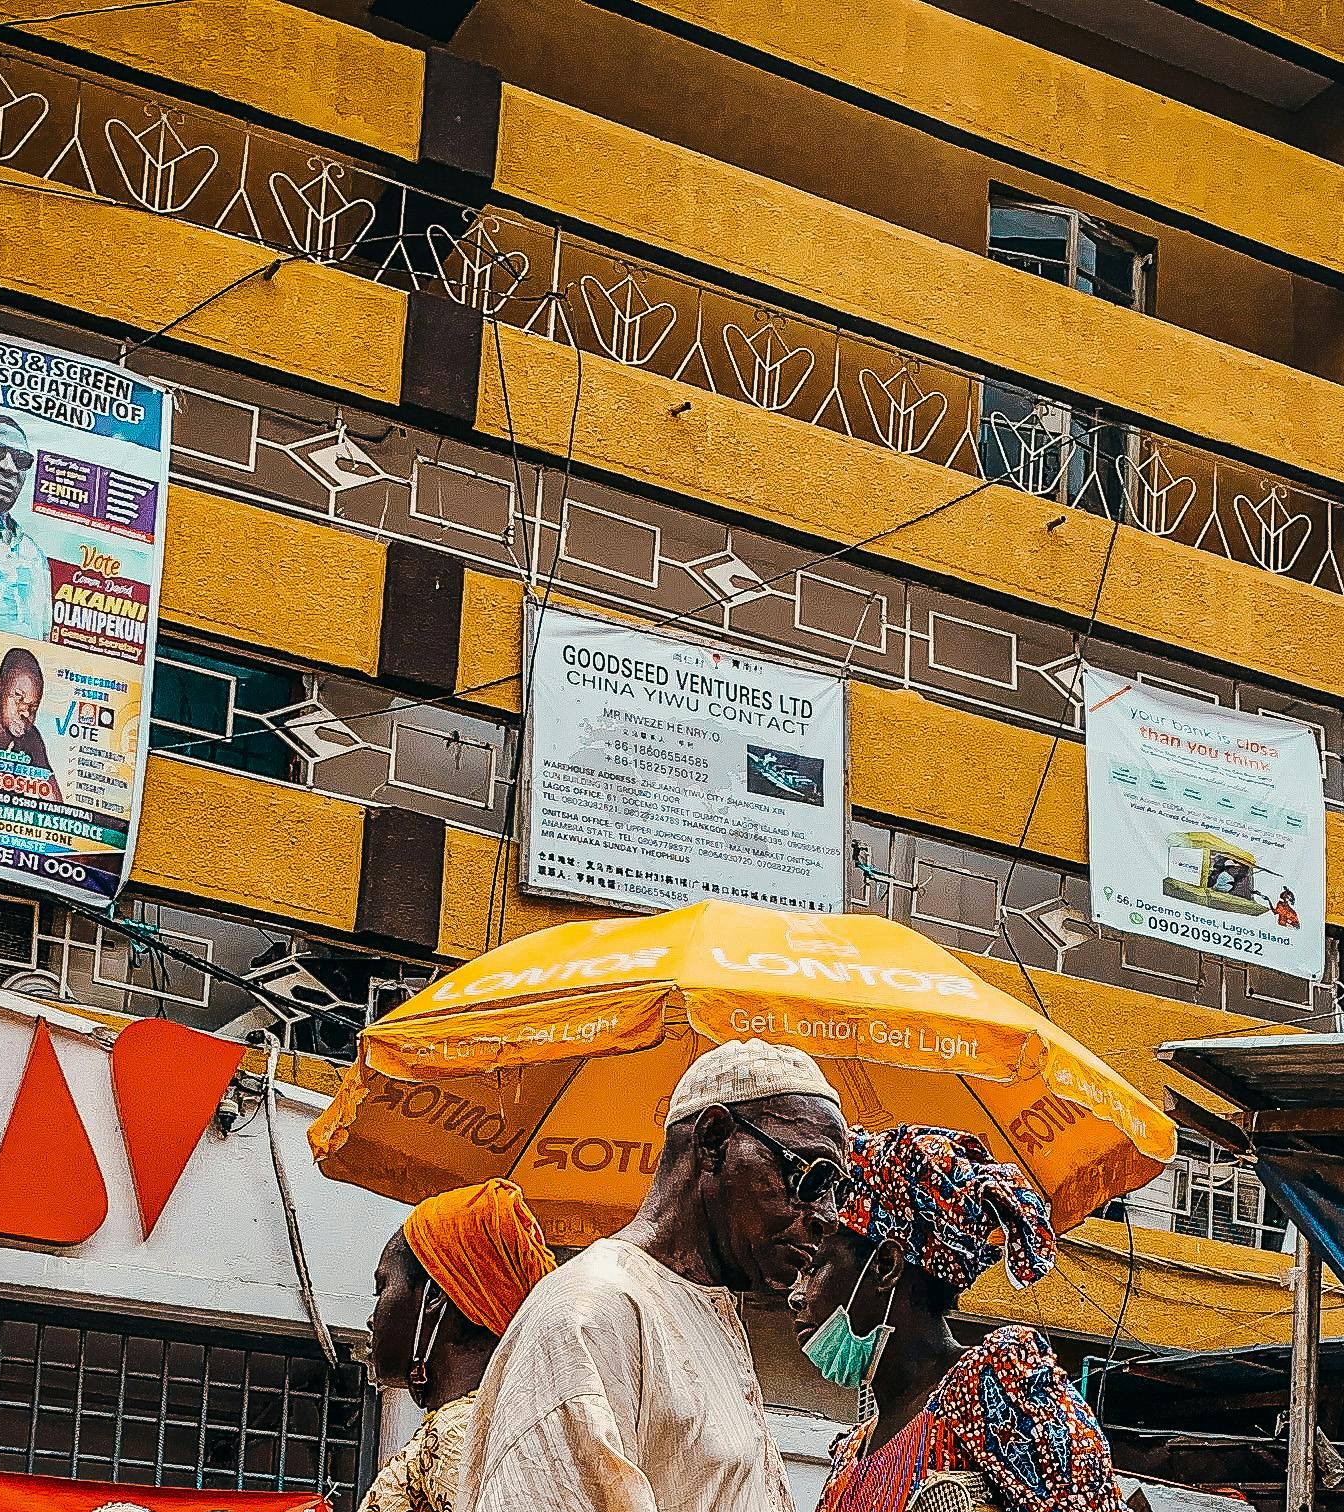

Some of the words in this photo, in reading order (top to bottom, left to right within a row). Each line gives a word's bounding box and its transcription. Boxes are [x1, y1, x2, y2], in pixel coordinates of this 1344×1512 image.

[27, 353, 46, 372] &
[50, 360, 133, 402] SCREEN
[8, 387, 94, 428] (SSPAN)
[114, 403, 144, 425] OF
[39, 480, 89, 503] ZENITH
[80, 545, 122, 578] Vote
[54, 583, 147, 622] AKANNI
[53, 601, 146, 645] OLANIPEKUN
[562, 644, 669, 686] GOODSEED
[676, 669, 772, 711] VENTURES
[779, 695, 813, 719] LTD
[566, 670, 635, 698] CHINA
[643, 687, 699, 713] YIWU
[708, 702, 809, 736] CONTACT
[603, 708, 621, 722] MR
[624, 713, 664, 730] NWEZE
[1129, 704, 1168, 726] your
[1172, 718, 1212, 740] bank
[1216, 730, 1231, 745] is
[1139, 724, 1182, 748] than
[1187, 738, 1219, 759] you
[1225, 750, 1272, 772] think
[543, 758, 596, 777] WAREHOUSE
[542, 781, 571, 793] LAGOS
[660, 804, 690, 817] STREET
[1158, 810, 1179, 821] Access
[37, 812, 104, 841] TASKFORCE
[45, 830, 73, 846] ZONE
[12, 839, 46, 853] WASTE
[18, 853, 40, 871] NI
[602, 841, 638, 854] SUNDAY
[1116, 893, 1133, 908] 56,
[1136, 898, 1181, 920] Docemo
[1184, 910, 1219, 930] Street,
[1222, 920, 1254, 939] Lagos
[1257, 929, 1292, 946] Island.
[1148, 916, 1264, 956] 09020992622
[433, 946, 670, 1001] LONTOR
[712, 946, 977, 999] LONTOR
[562, 1014, 618, 1042] Light
[730, 1008, 776, 1034] Get
[869, 1021, 911, 1050] Get
[919, 1033, 980, 1061] Light
